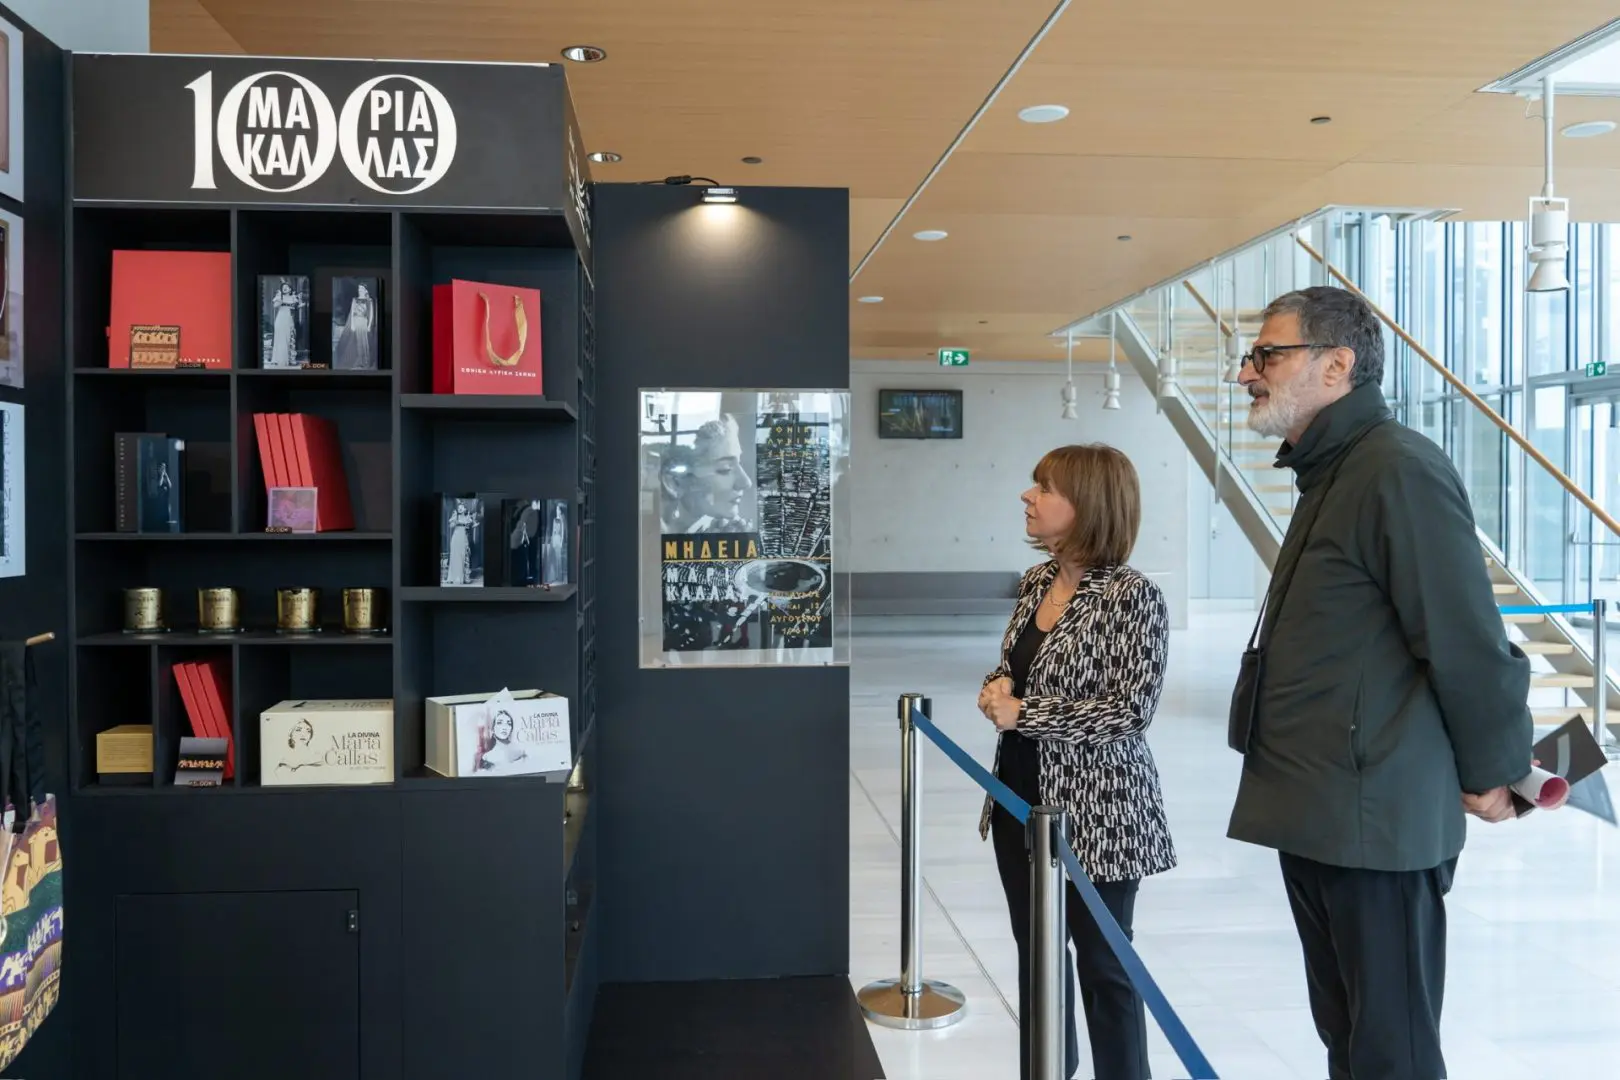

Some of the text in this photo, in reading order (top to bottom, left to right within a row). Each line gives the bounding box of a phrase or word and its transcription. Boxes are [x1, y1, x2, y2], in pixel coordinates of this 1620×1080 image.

[247, 86, 433, 132] ΜΑ ΡΙΑ
[243, 133, 434, 178] ΚΑΛ ΛΑΣ
[665, 539, 758, 560] ΜΗΔΕΙΑ
[332, 735, 381, 750] Maria
[324, 749, 378, 765] Callas
